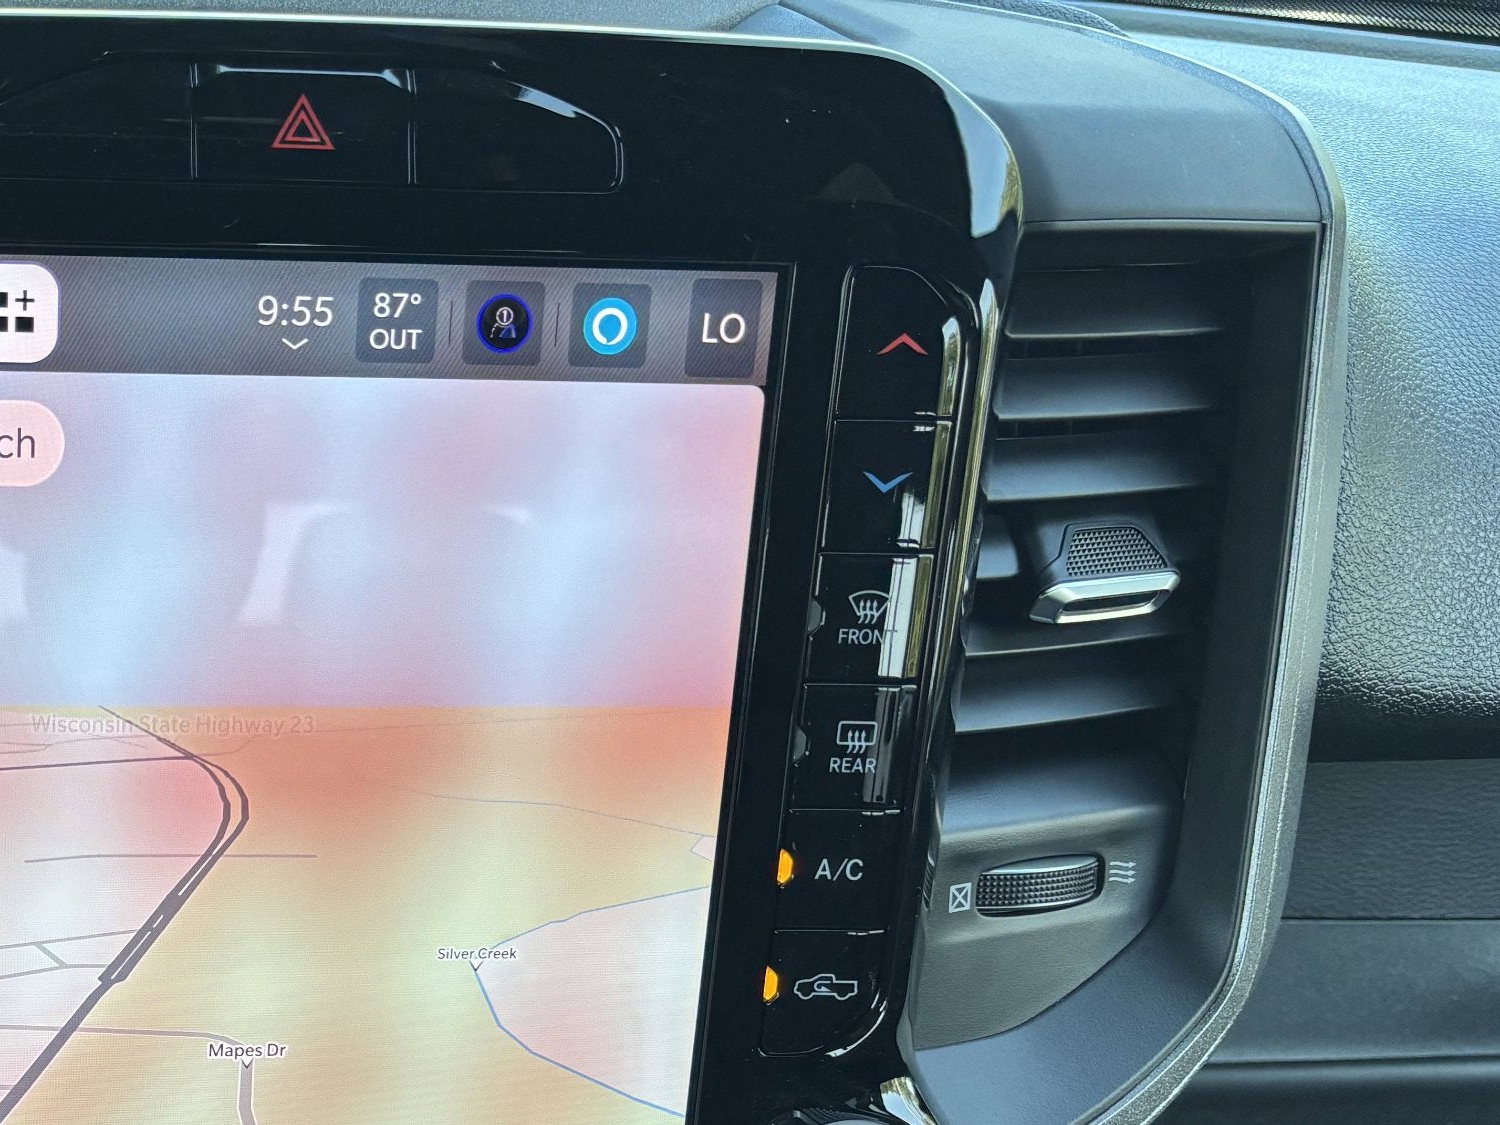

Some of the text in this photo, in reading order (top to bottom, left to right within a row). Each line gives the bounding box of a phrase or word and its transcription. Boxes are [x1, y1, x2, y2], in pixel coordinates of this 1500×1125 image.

[257, 295, 335, 328] 9:55
[702, 313, 746, 344] LO
[369, 329, 421, 350] OUT
[837, 627, 898, 646] FRONT
[31, 715, 315, 741] Wisconsin State Highway 23
[828, 757, 876, 774] REAR
[815, 857, 864, 881] A/C
[437, 947, 517, 960] Silver Creek
[208, 1042, 287, 1062] Mapes Dr
